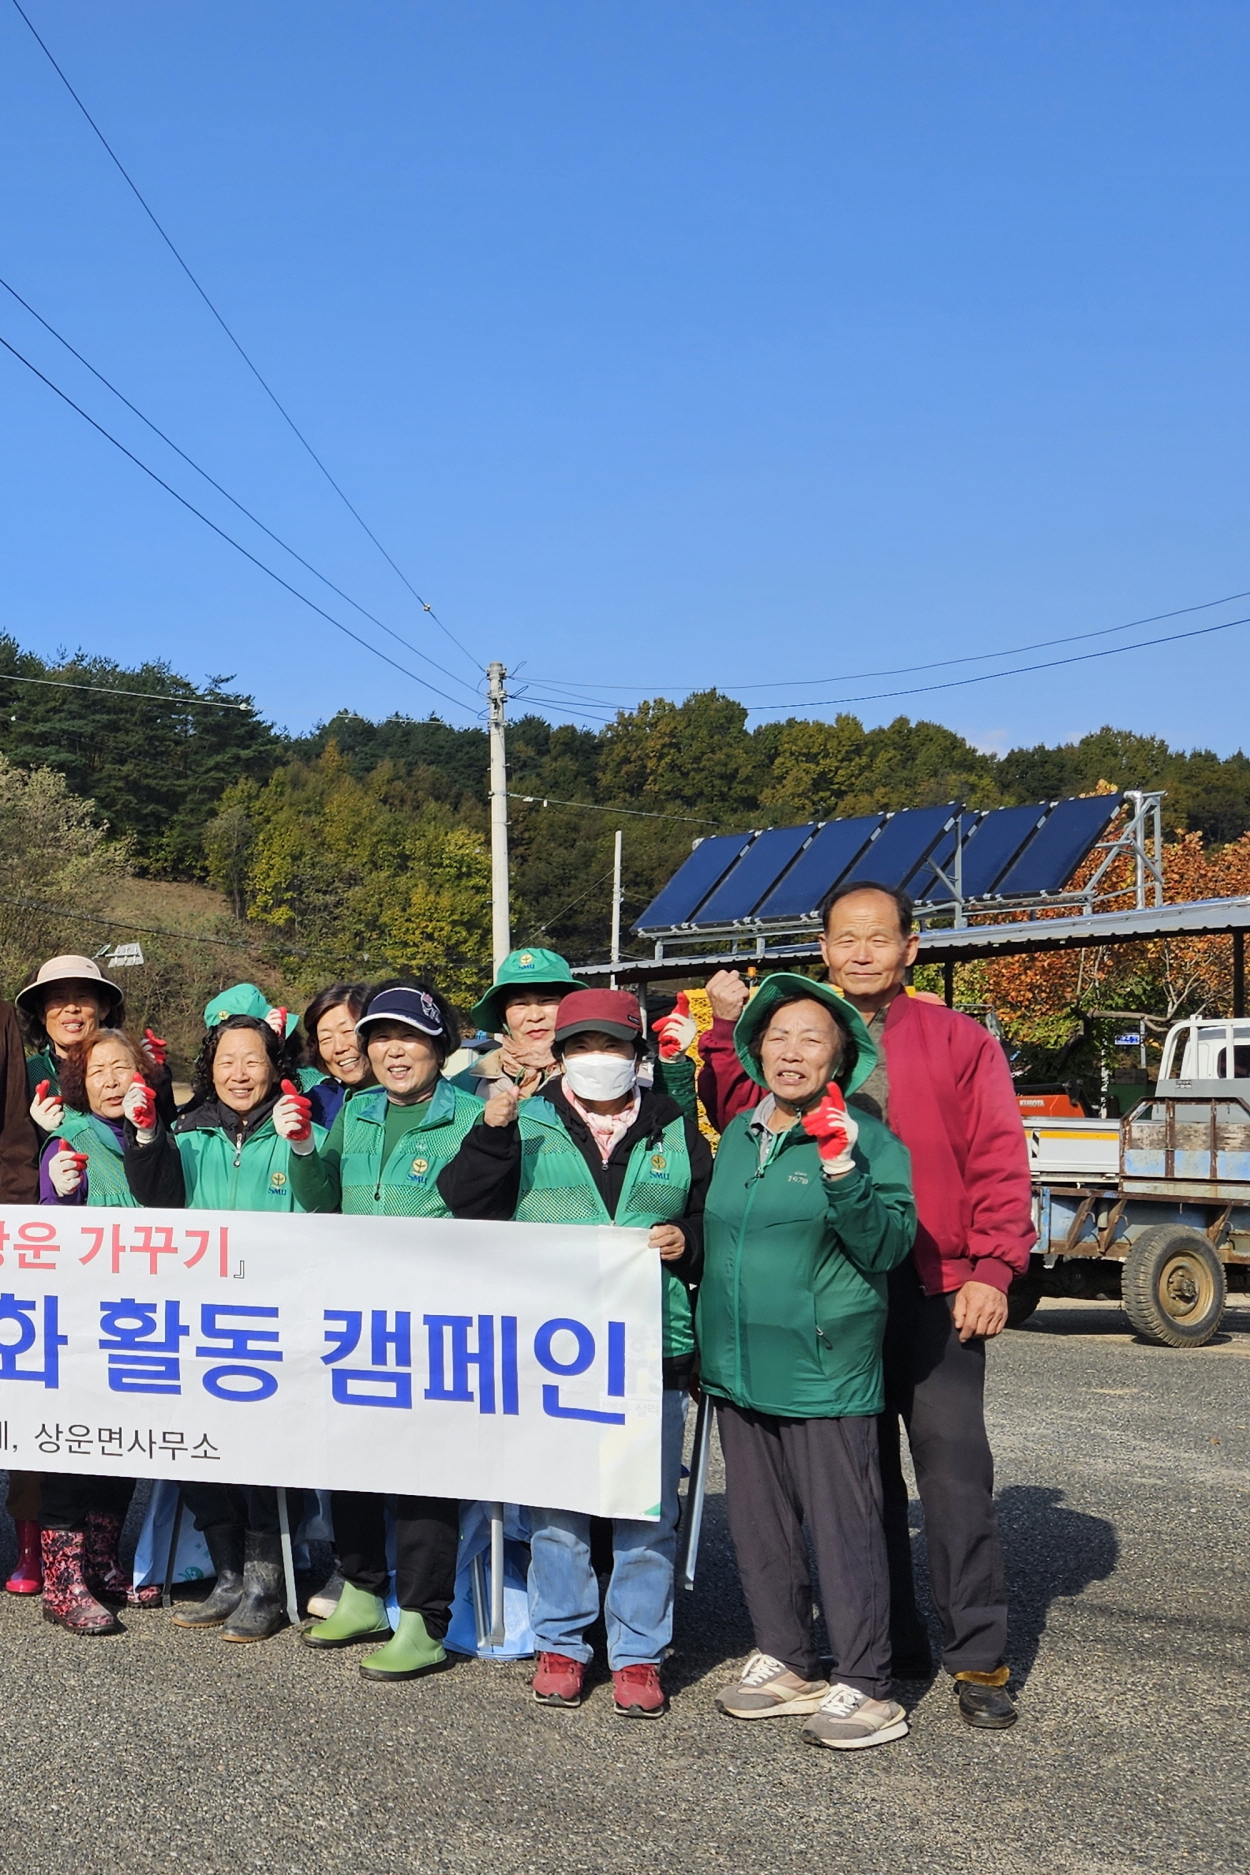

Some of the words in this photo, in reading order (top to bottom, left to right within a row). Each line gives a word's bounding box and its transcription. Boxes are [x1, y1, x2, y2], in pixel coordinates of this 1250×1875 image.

[1019, 1099, 1045, 1108] KUBOTA
[406, 1173, 428, 1185] SMU
[649, 1170, 670, 1181] SMU
[268, 1187, 287, 1196] SMU
[78, 1223, 245, 1279] 가꾸기』
[98, 1298, 284, 1403] 활동
[320, 1309, 626, 1425] 캠페인
[34, 1423, 221, 1461] 상운면사무소
